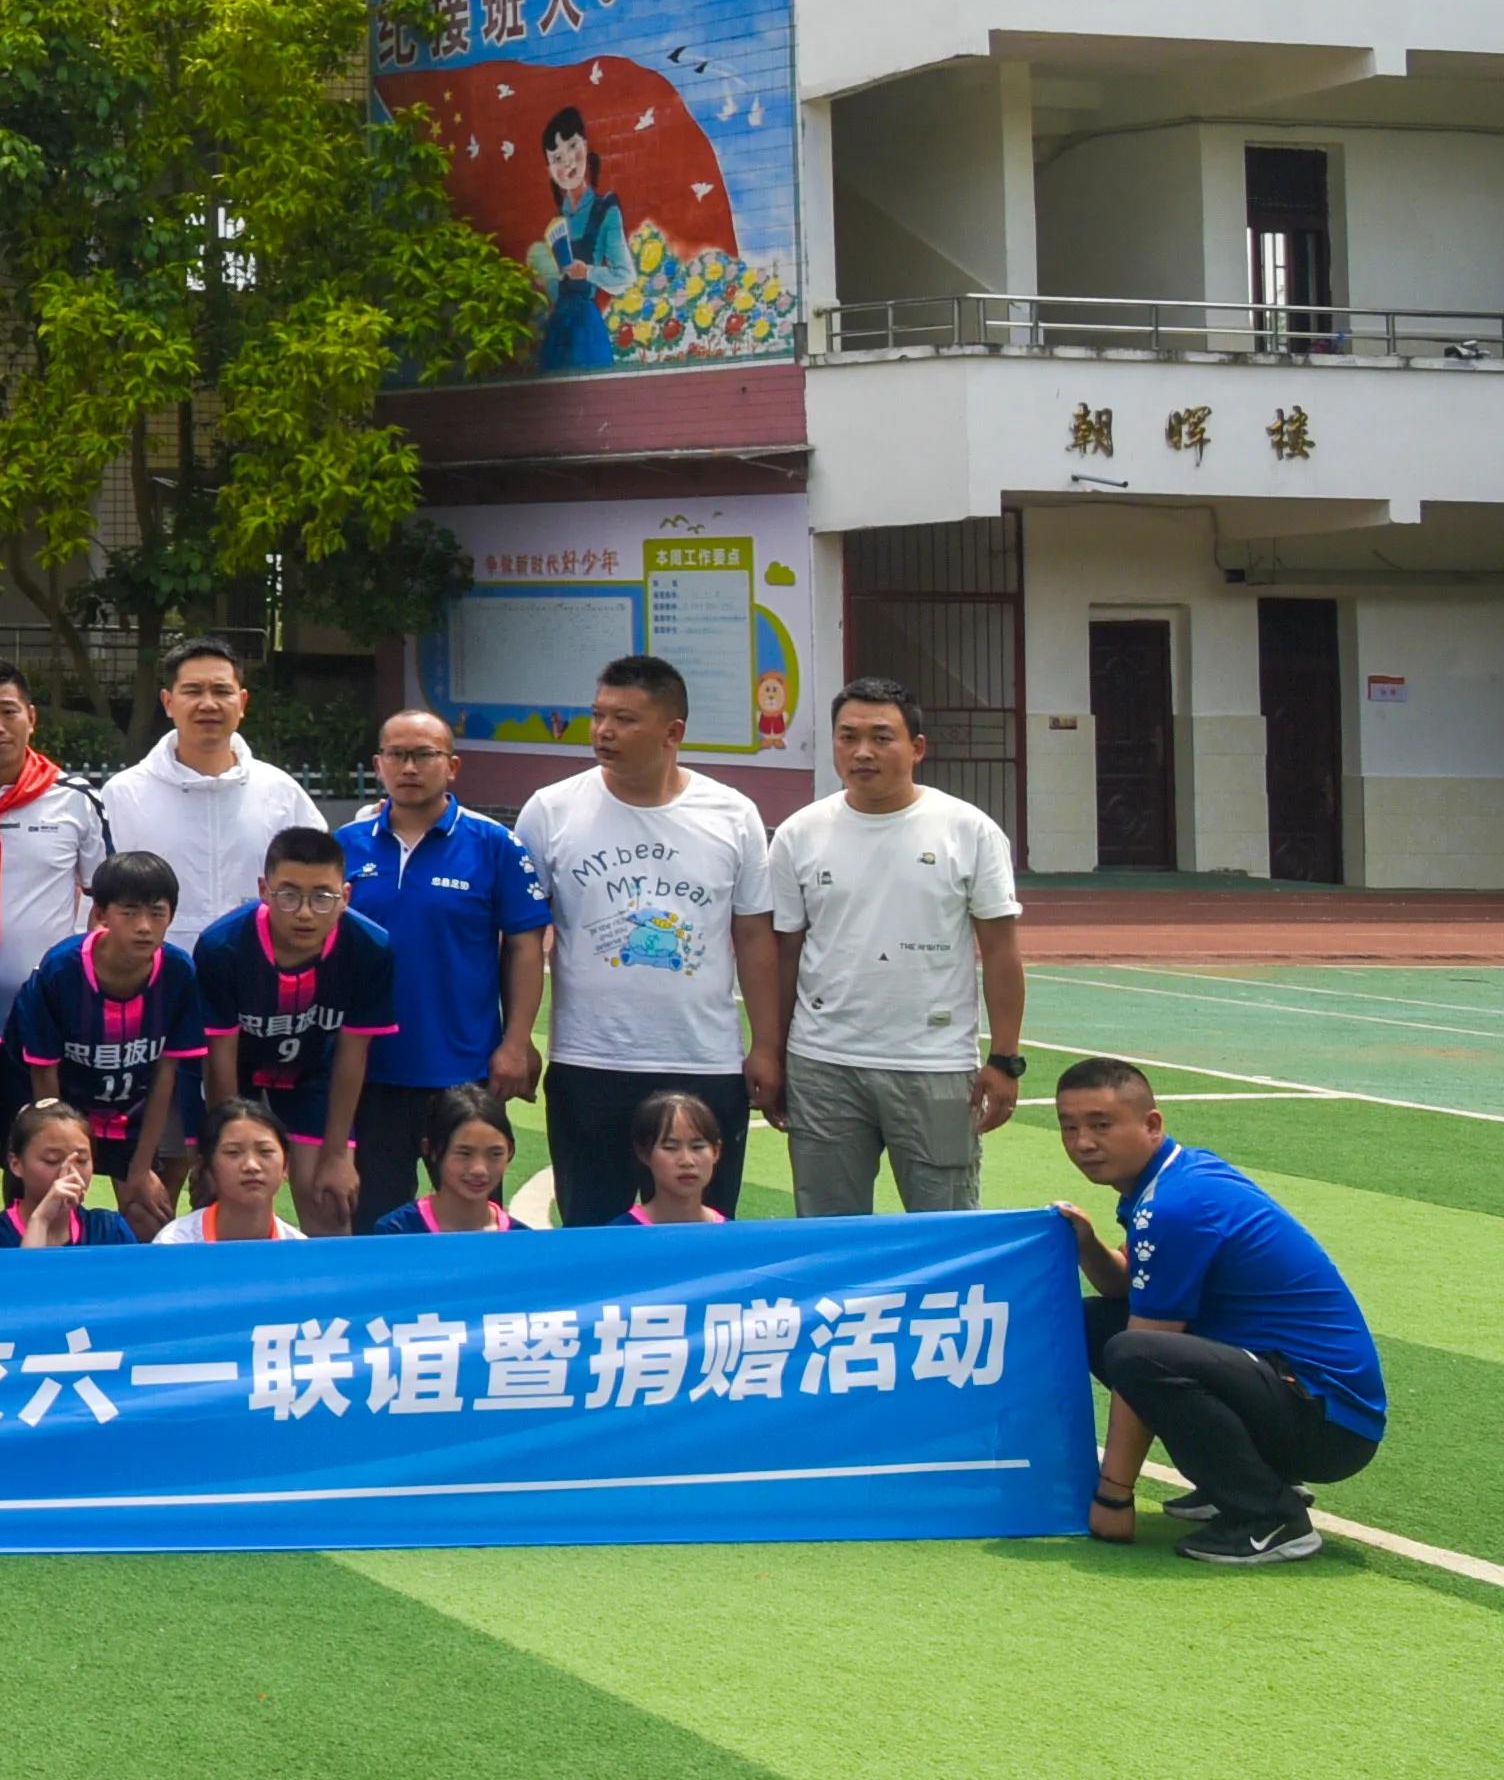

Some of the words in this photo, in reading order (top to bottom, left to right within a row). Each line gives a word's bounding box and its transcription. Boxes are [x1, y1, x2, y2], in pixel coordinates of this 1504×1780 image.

[1065, 402, 1316, 467] 朝晖楼
[655, 548, 741, 567] 本周工作要点
[238, 1004, 344, 1038] 忠县拔山
[277, 1038, 301, 1063] 9
[94, 1071, 134, 1102] 11
